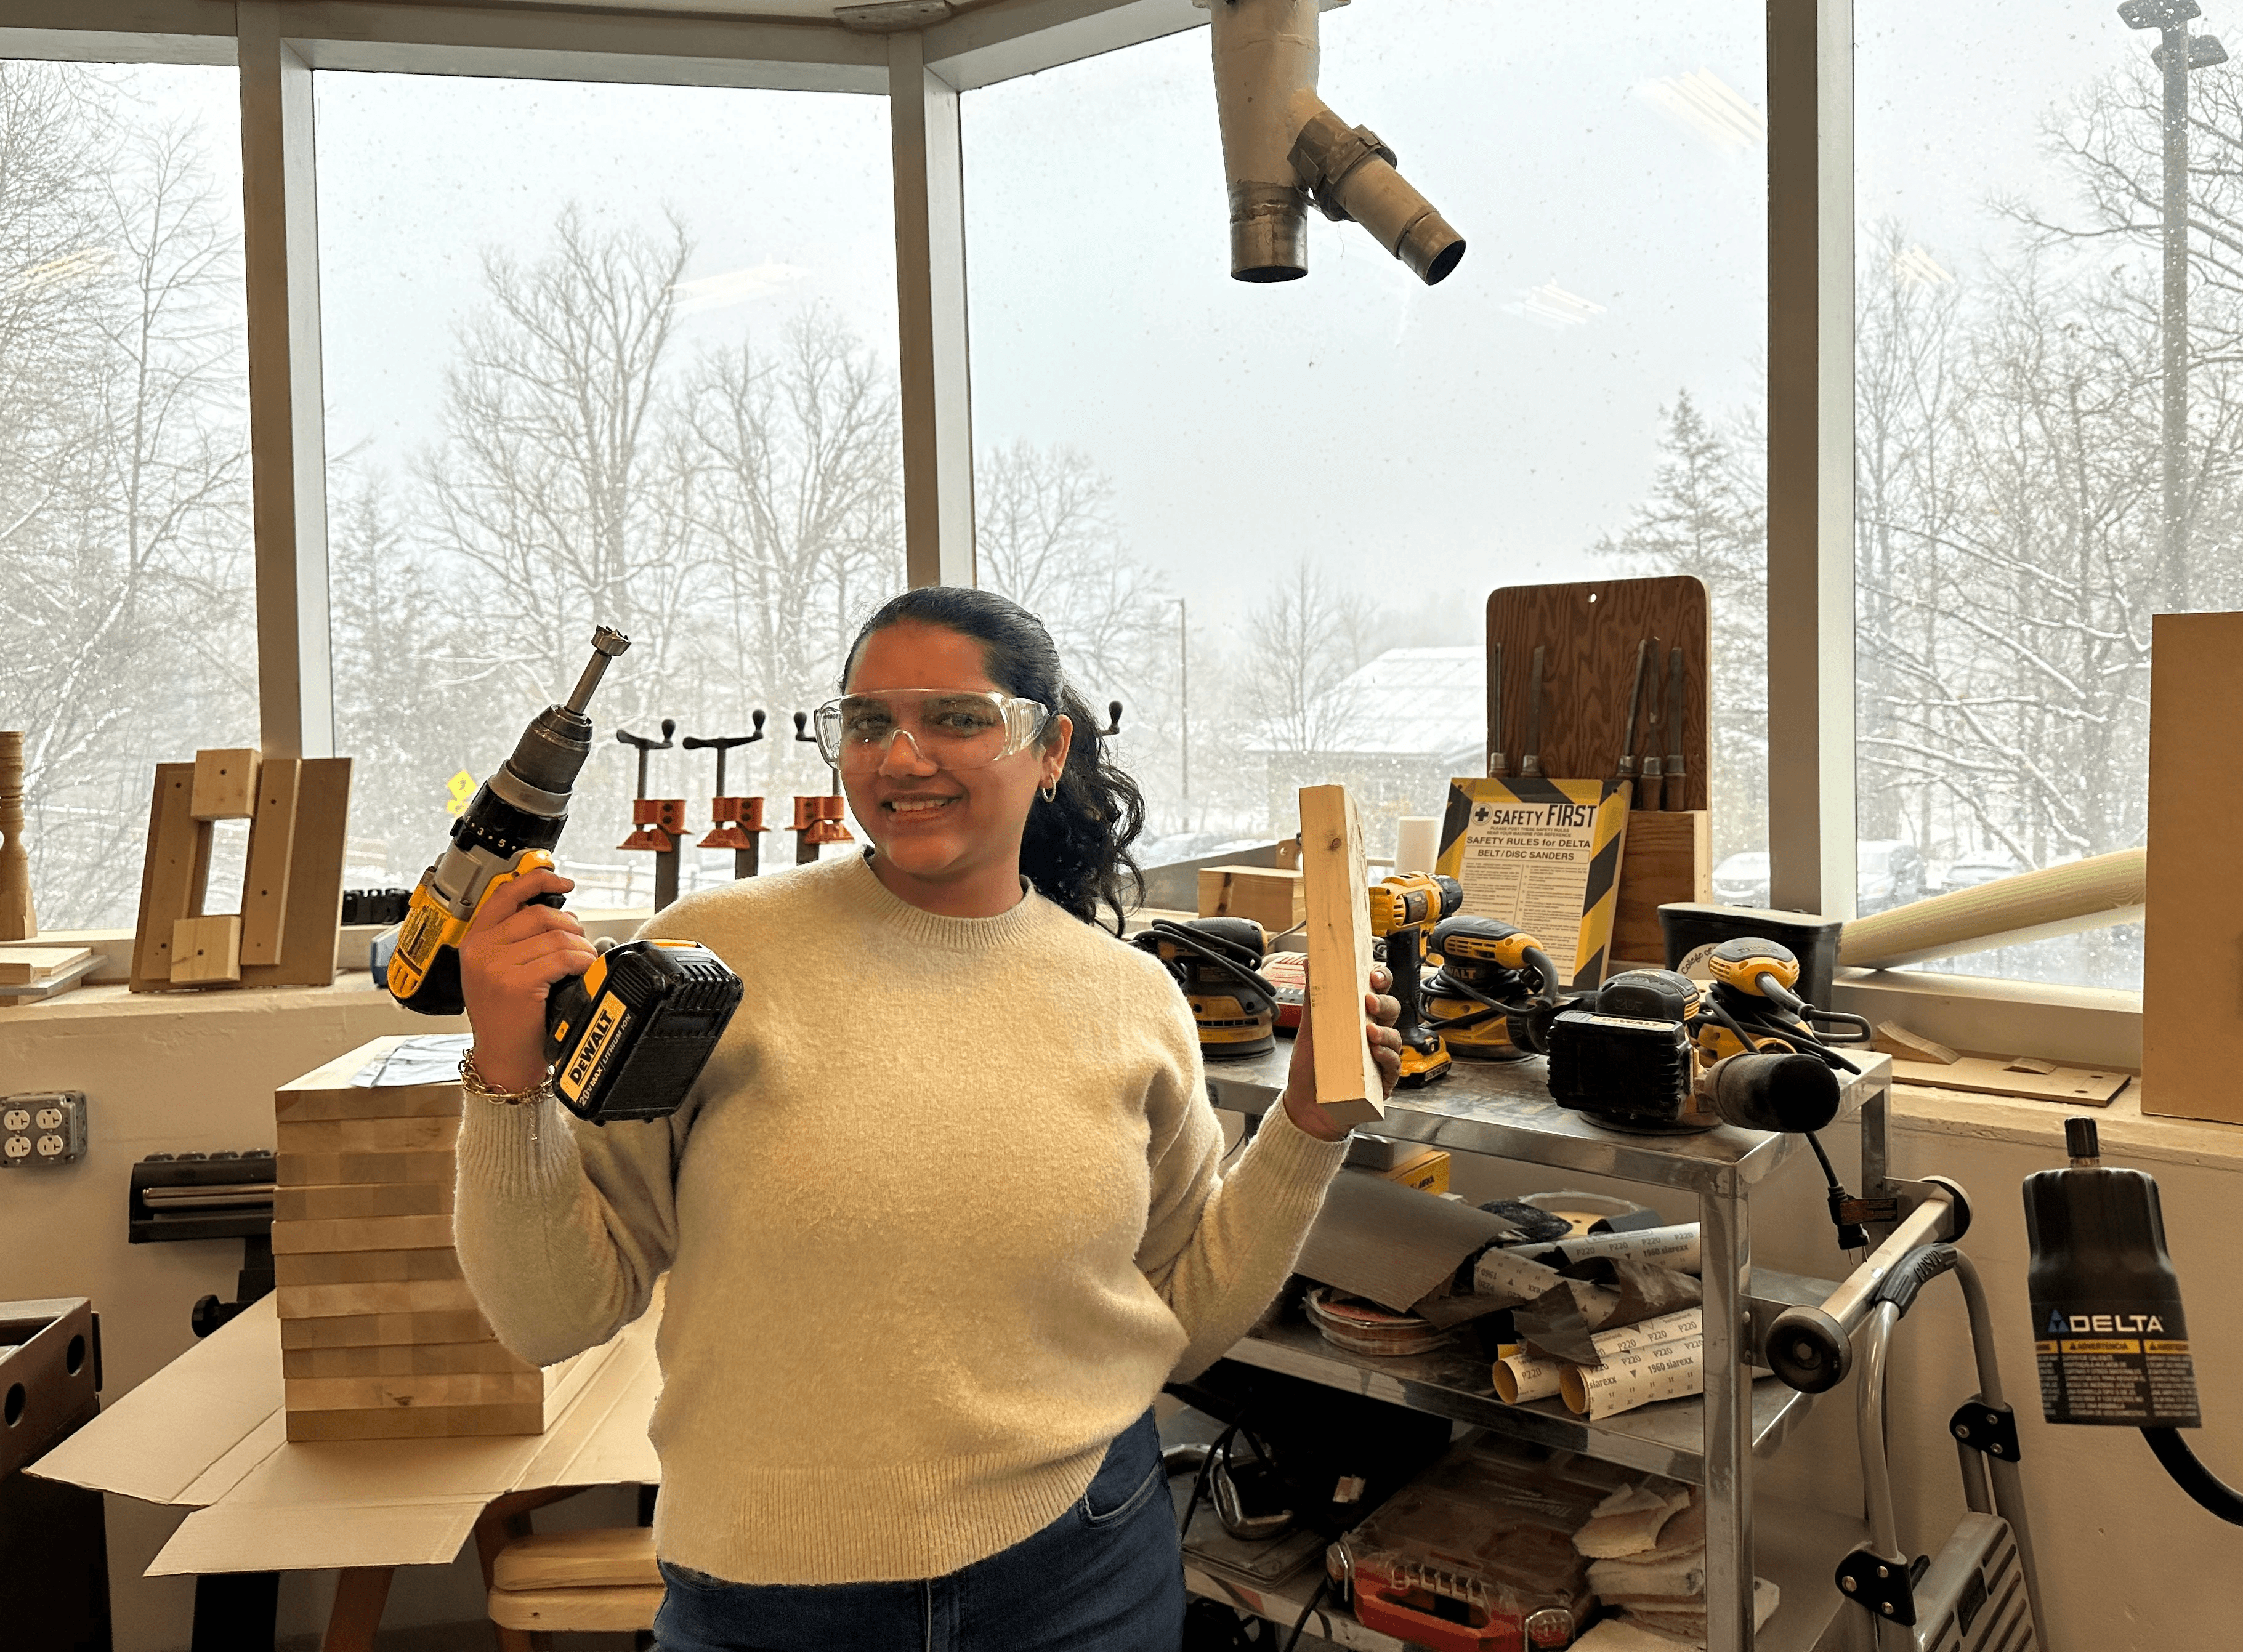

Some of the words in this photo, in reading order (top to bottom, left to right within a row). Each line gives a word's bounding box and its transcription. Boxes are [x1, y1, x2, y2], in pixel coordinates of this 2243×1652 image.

[1493, 810, 1544, 826] SAFETY
[1546, 805, 1597, 828] FIRST
[477, 827, 484, 836] 3
[498, 839, 506, 847] 5
[1466, 836, 1504, 845] SAFETY
[1506, 837, 1540, 846] RULES
[1542, 839, 1556, 847] for
[1558, 839, 1591, 848] DELTA
[1529, 851, 1574, 861] SANDERS
[1445, 966, 1477, 980] WALT
[1601, 1017, 1659, 1027] DEWALT
[602, 1029, 623, 1065] LITHIUM
[620, 1013, 632, 1031] ION
[569, 1009, 612, 1086] DEWALT
[1641, 1236, 1662, 1246] P220
[1673, 1232, 1694, 1241] P220
[1576, 1246, 1596, 1257] P220
[1609, 1241, 1629, 1252] P220
[1678, 1321, 1698, 1333] P220
[2069, 1315, 2164, 1332] DELTA
[1647, 1330, 1668, 1342] P220
[1617, 1339, 1637, 1351] P220
[1652, 1347, 1674, 1358] P220
[1621, 1355, 1642, 1366] P220
[1521, 1367, 1542, 1382] P220
[1647, 1362, 1666, 1375] 1960
